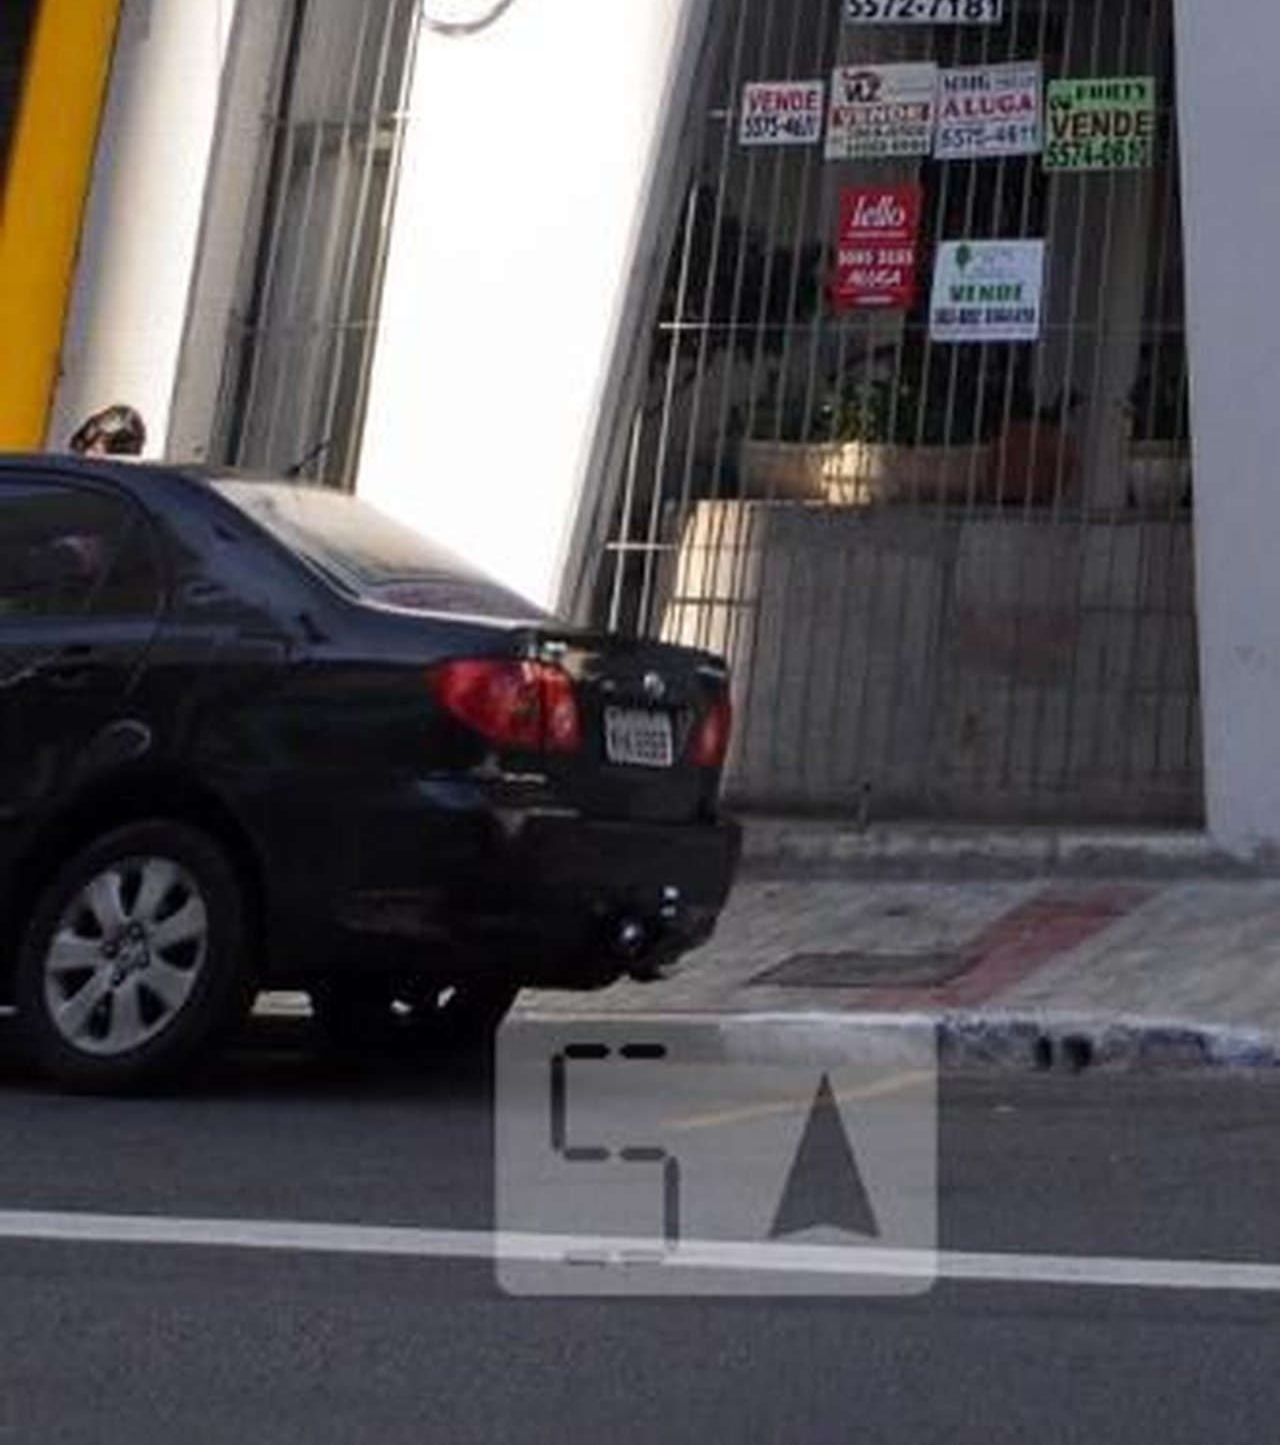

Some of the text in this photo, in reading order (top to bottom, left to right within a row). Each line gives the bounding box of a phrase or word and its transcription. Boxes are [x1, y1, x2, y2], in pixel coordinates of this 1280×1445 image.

[750, 89, 818, 111] VENDE
[944, 93, 1033, 117] ALUGA
[1050, 110, 1151, 140] VENDE
